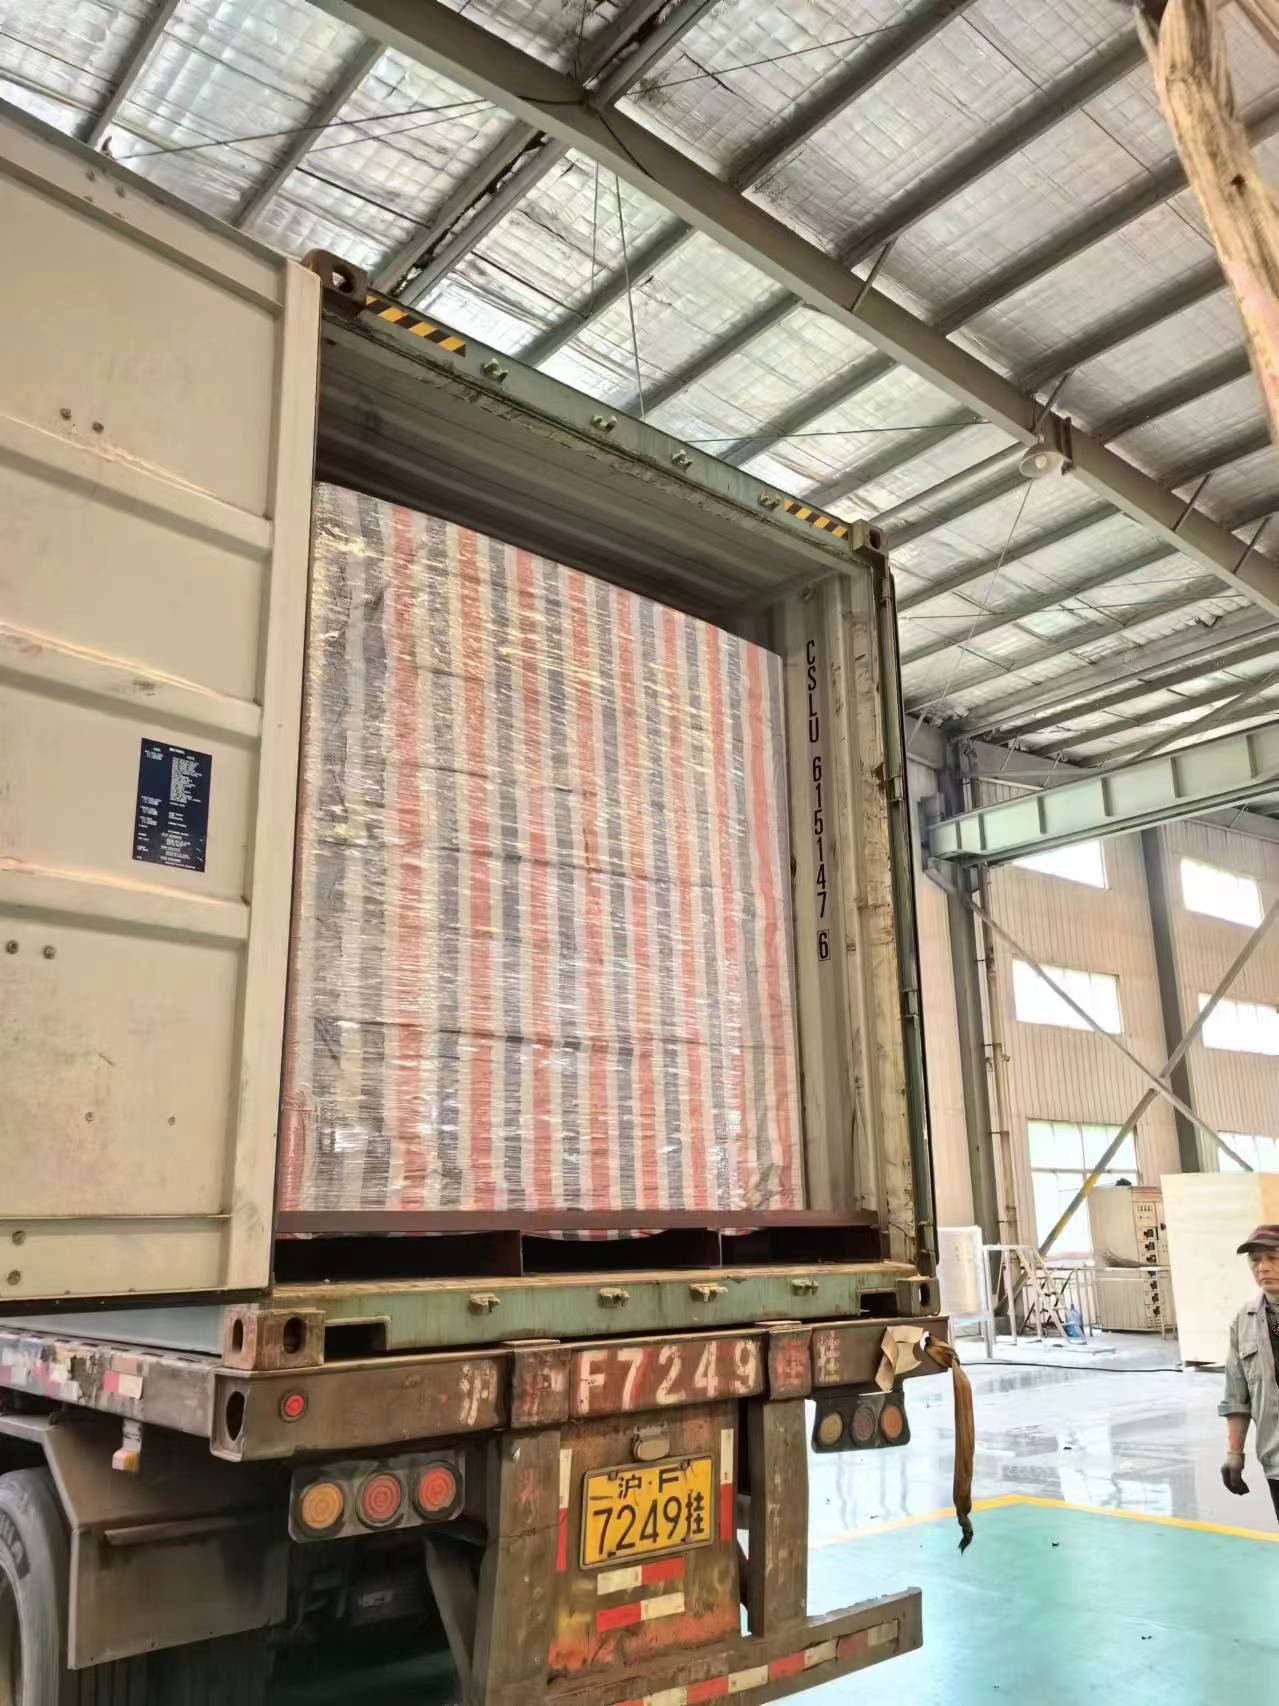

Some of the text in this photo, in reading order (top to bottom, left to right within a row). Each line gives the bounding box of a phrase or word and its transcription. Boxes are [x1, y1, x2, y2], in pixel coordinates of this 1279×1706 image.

[806, 639, 829, 959] CSLU 615147 6
[576, 1338, 758, 1414] F7249
[593, 1489, 704, 1555] 7249挂
